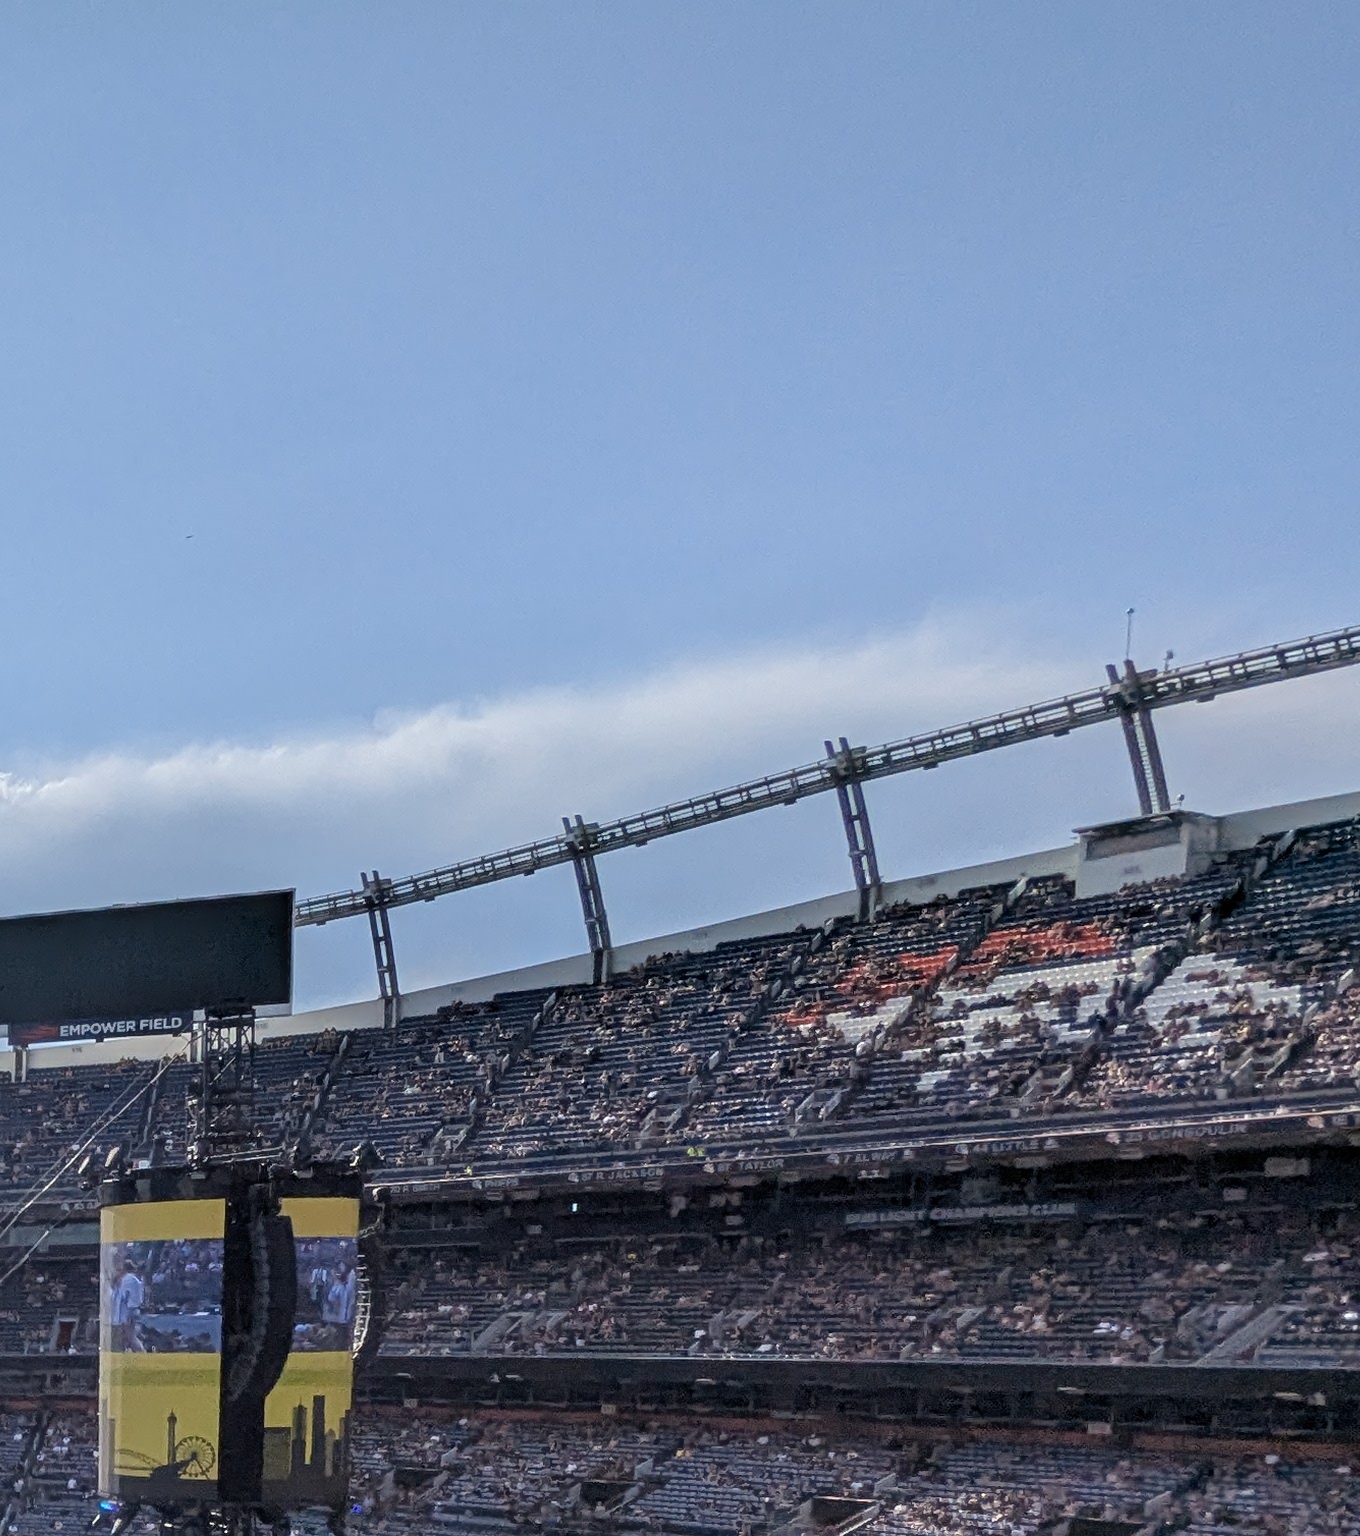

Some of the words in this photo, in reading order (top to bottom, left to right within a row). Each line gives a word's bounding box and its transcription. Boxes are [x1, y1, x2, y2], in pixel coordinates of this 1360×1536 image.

[59, 1020, 136, 1037] EMPOWER
[139, 1017, 183, 1031] FIELD
[608, 1168, 665, 1180] JACKSON
